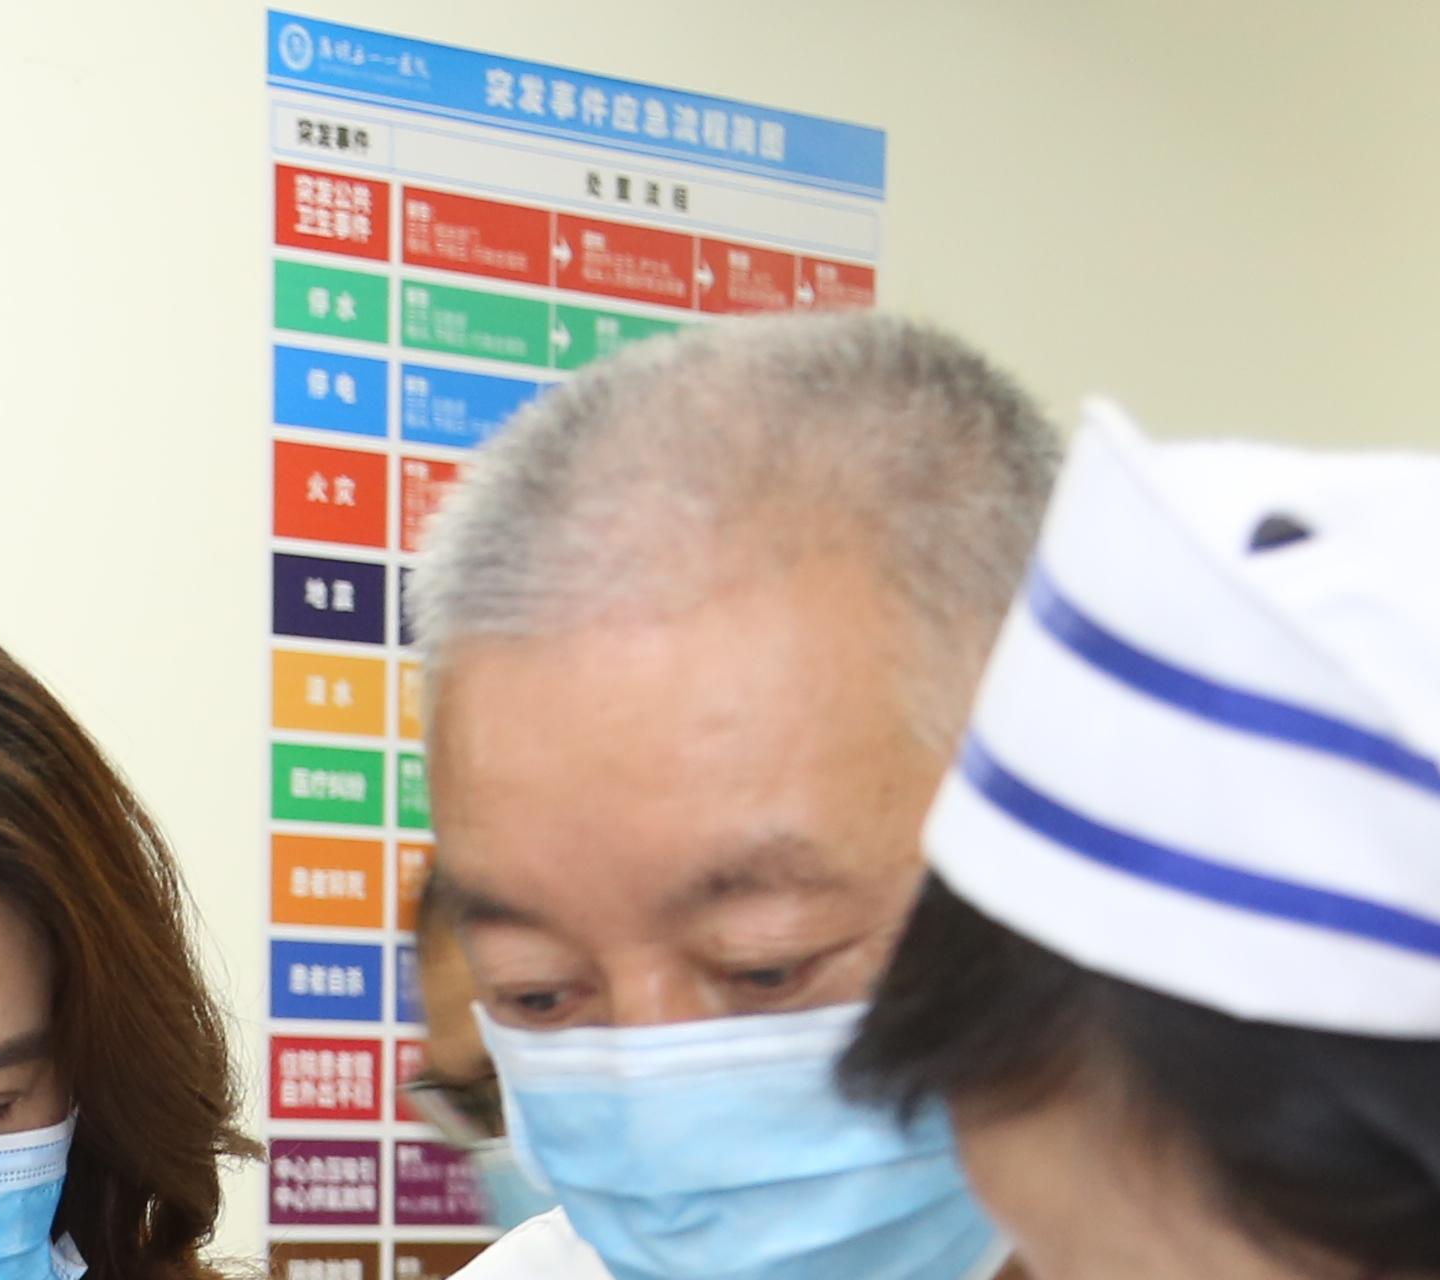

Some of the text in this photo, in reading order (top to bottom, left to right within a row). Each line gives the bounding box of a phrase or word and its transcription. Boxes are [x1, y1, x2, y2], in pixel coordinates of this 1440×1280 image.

[484, 67, 786, 162] 突发事件应急流程简图
[296, 117, 370, 153] 突发事件
[294, 173, 372, 215] 突发公共
[294, 203, 372, 244] 卫生事件
[306, 471, 356, 507] 火灾
[304, 577, 355, 612] 地震
